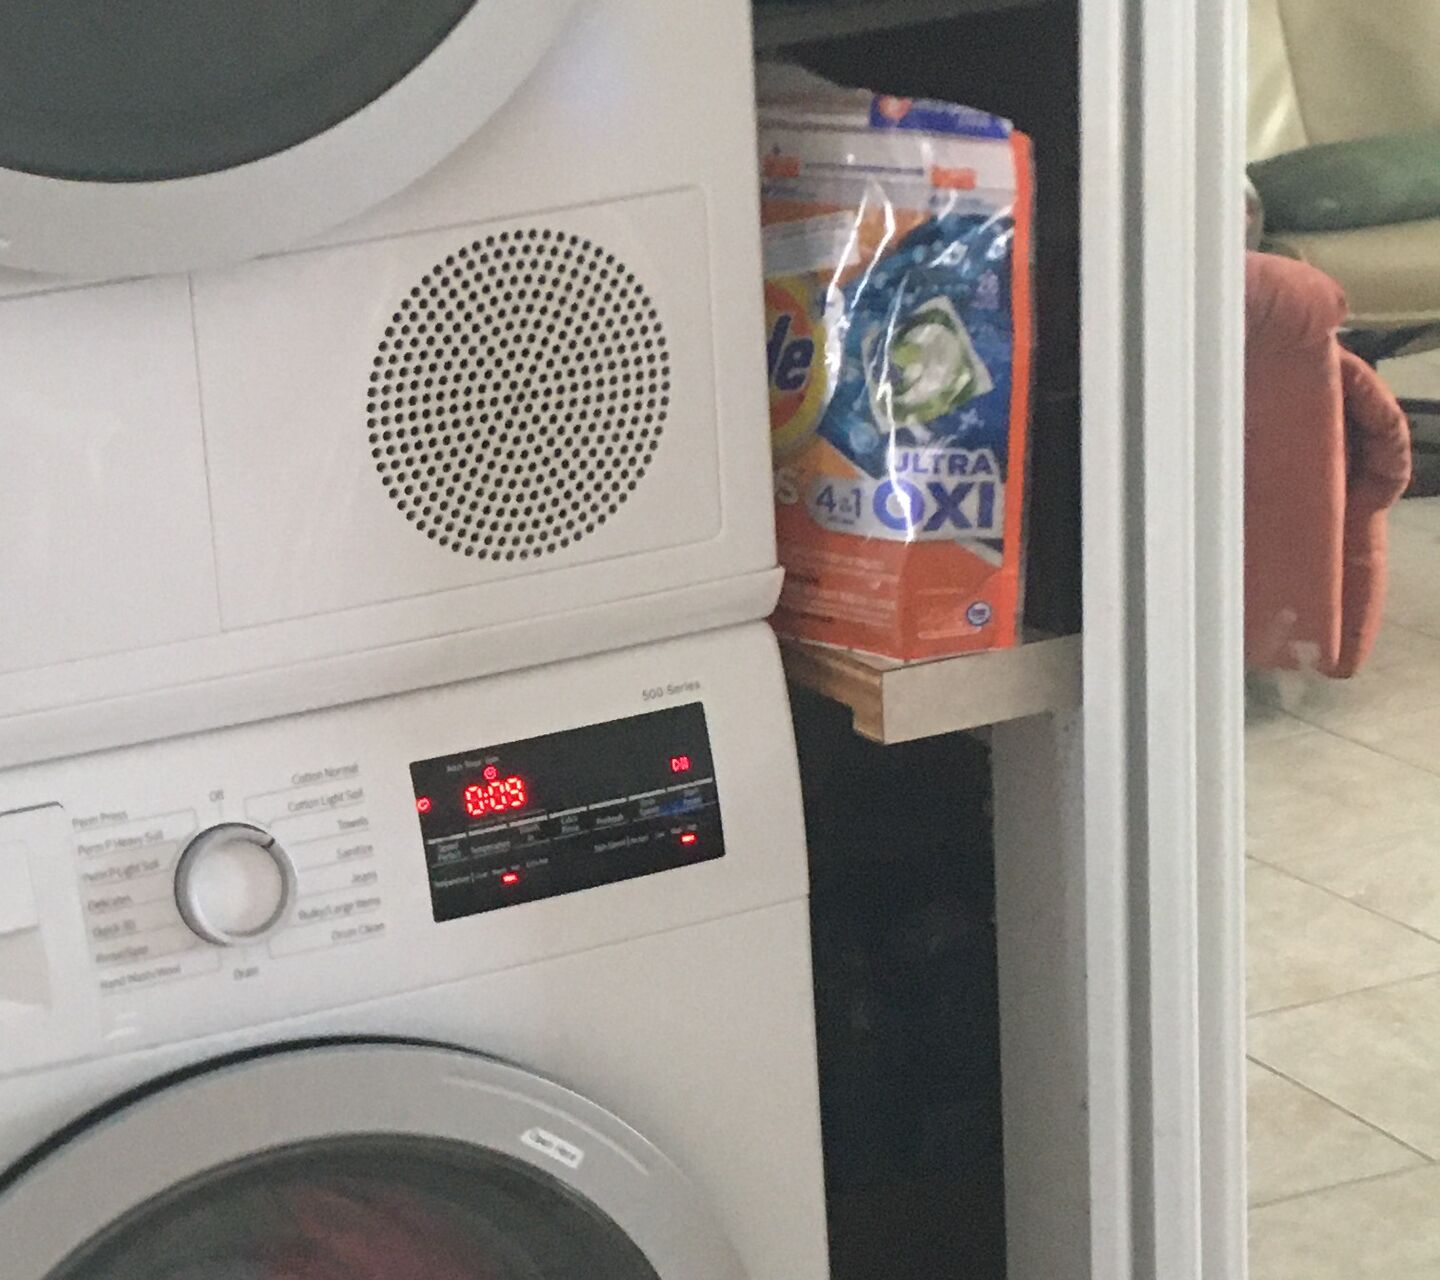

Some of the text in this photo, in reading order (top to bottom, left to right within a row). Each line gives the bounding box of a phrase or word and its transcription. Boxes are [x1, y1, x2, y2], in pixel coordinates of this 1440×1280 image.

[872, 477, 996, 532] OXI
[642, 686, 664, 701] 500
[464, 777, 525, 816] 0:09
